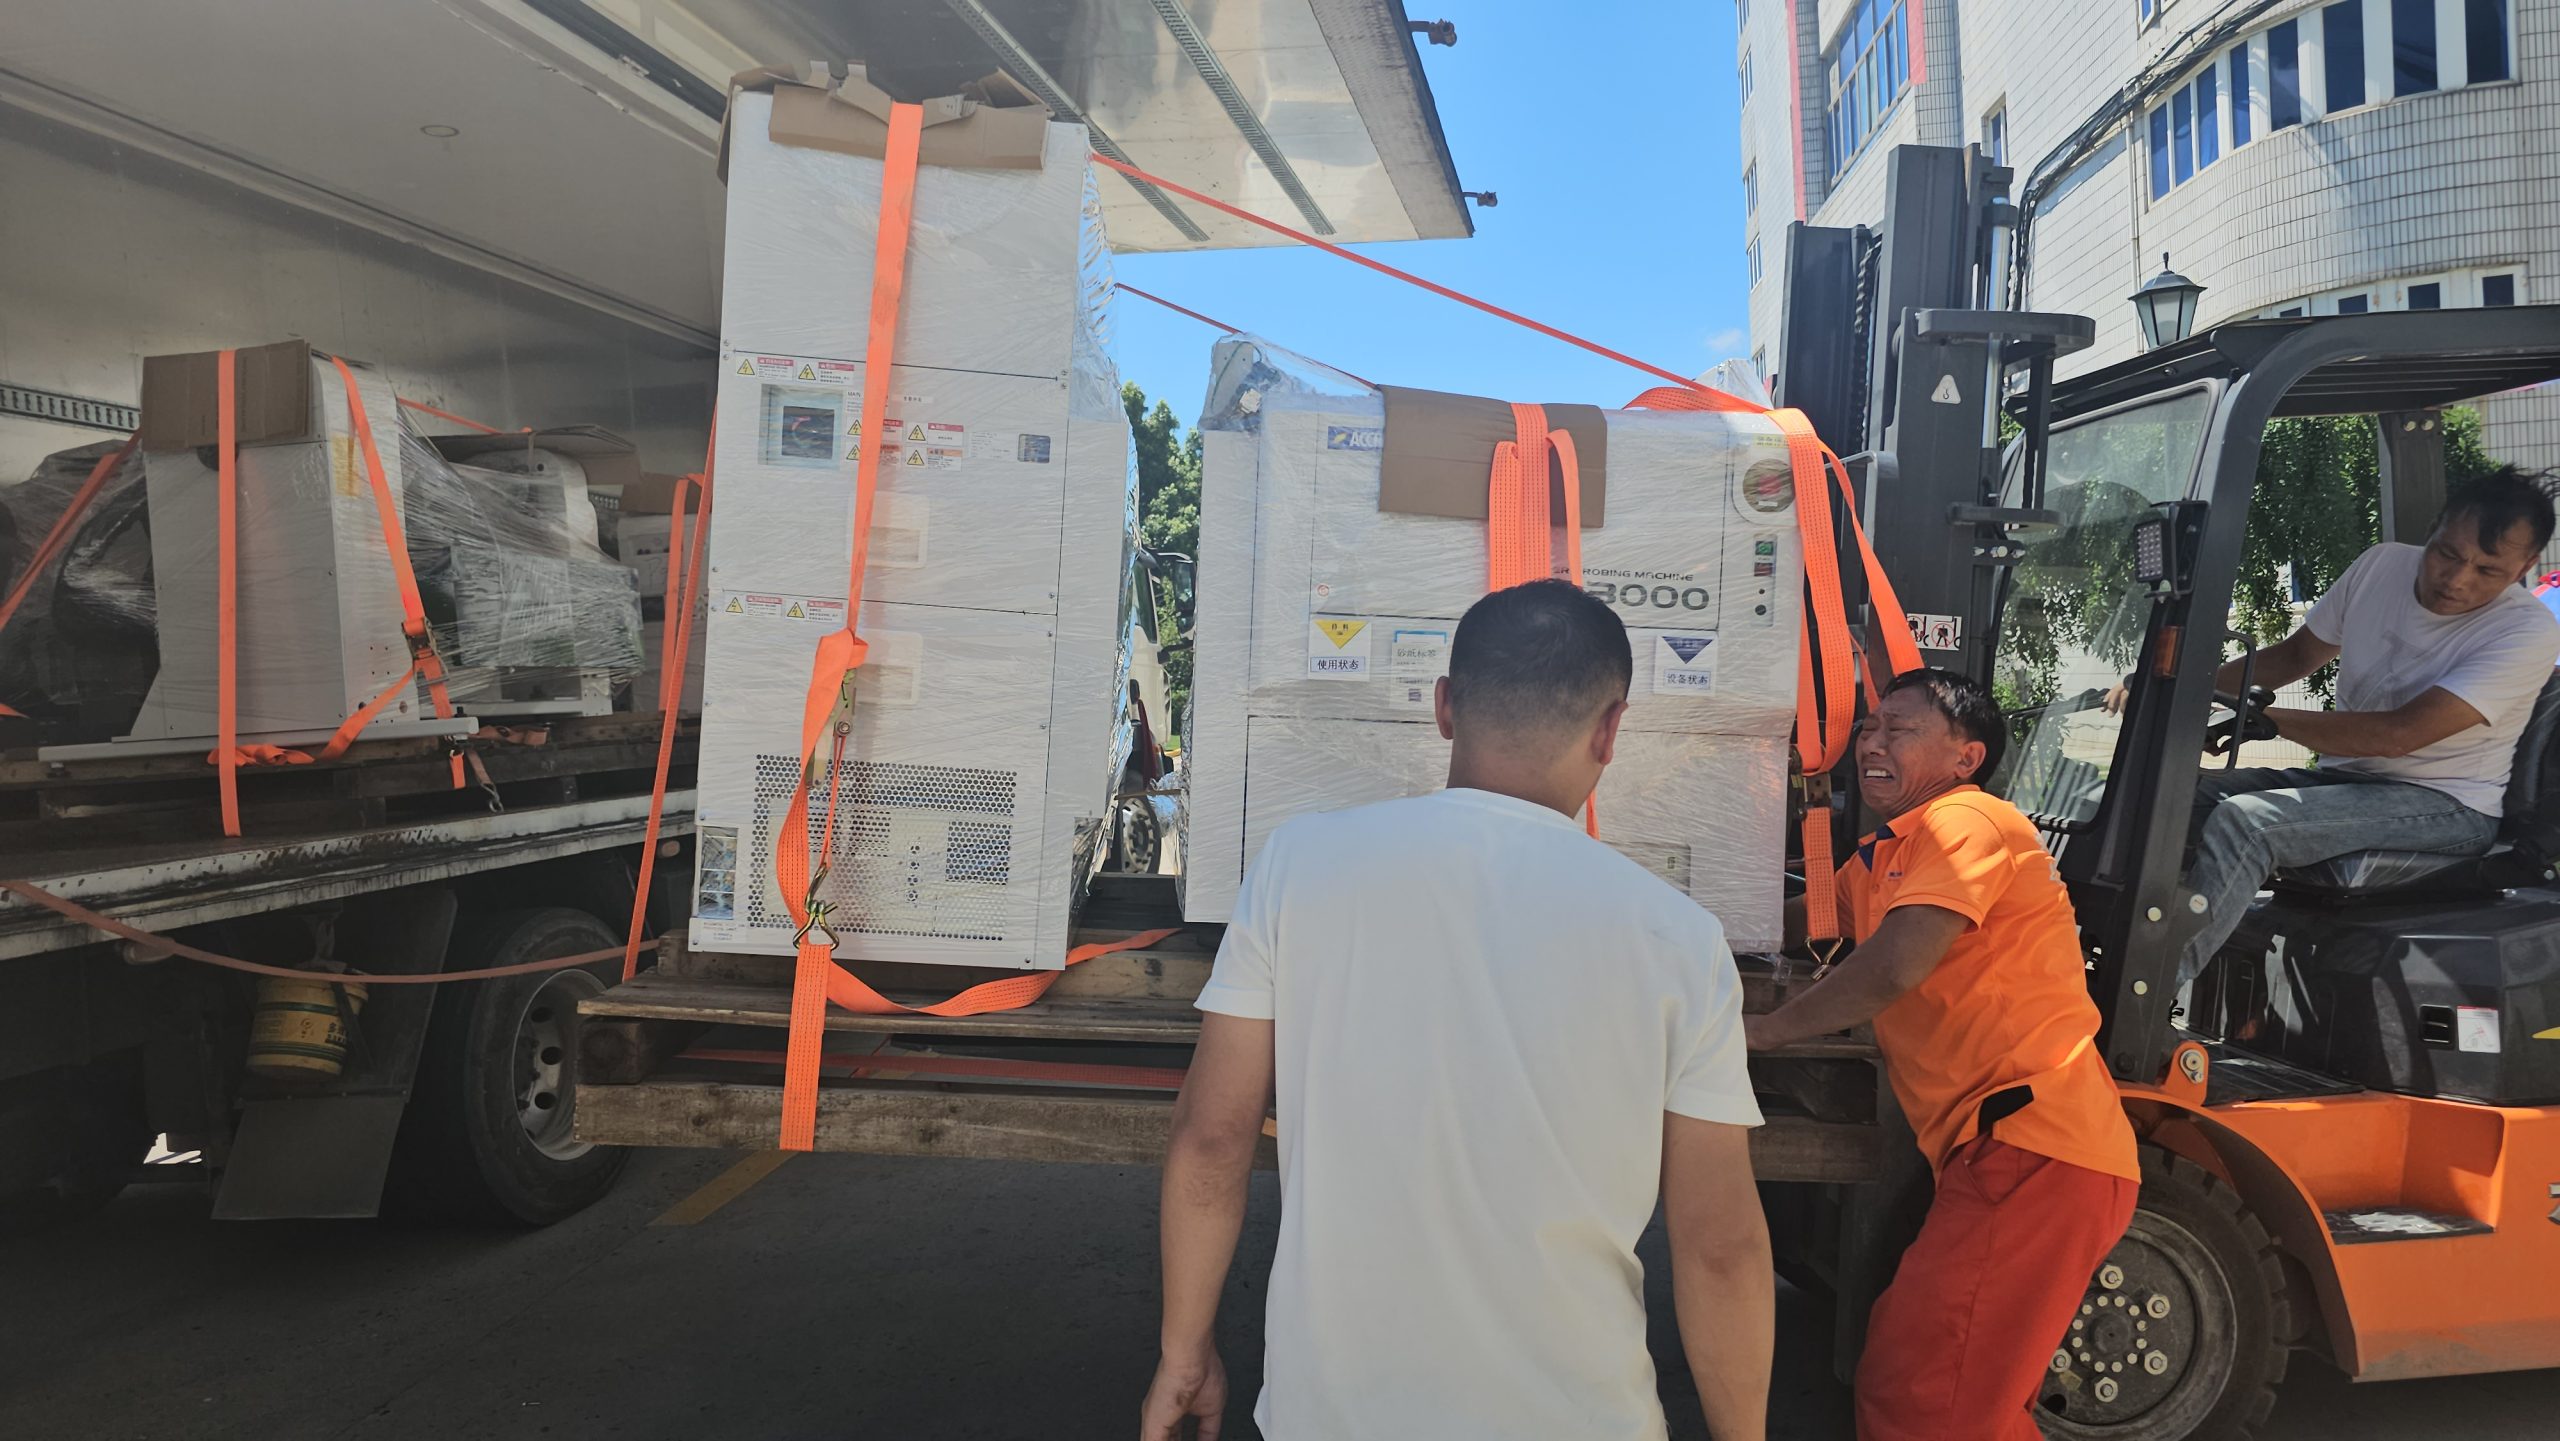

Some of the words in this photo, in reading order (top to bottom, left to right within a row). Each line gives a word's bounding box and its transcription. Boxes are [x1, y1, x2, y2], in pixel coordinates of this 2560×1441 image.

[1583, 568, 1631, 578] ROBING
[1635, 571, 1694, 581] MACHINE
[1587, 580, 1710, 611] 3000
[1317, 659, 1359, 670] 使用状态
[1667, 674, 1709, 685] 设备状态
